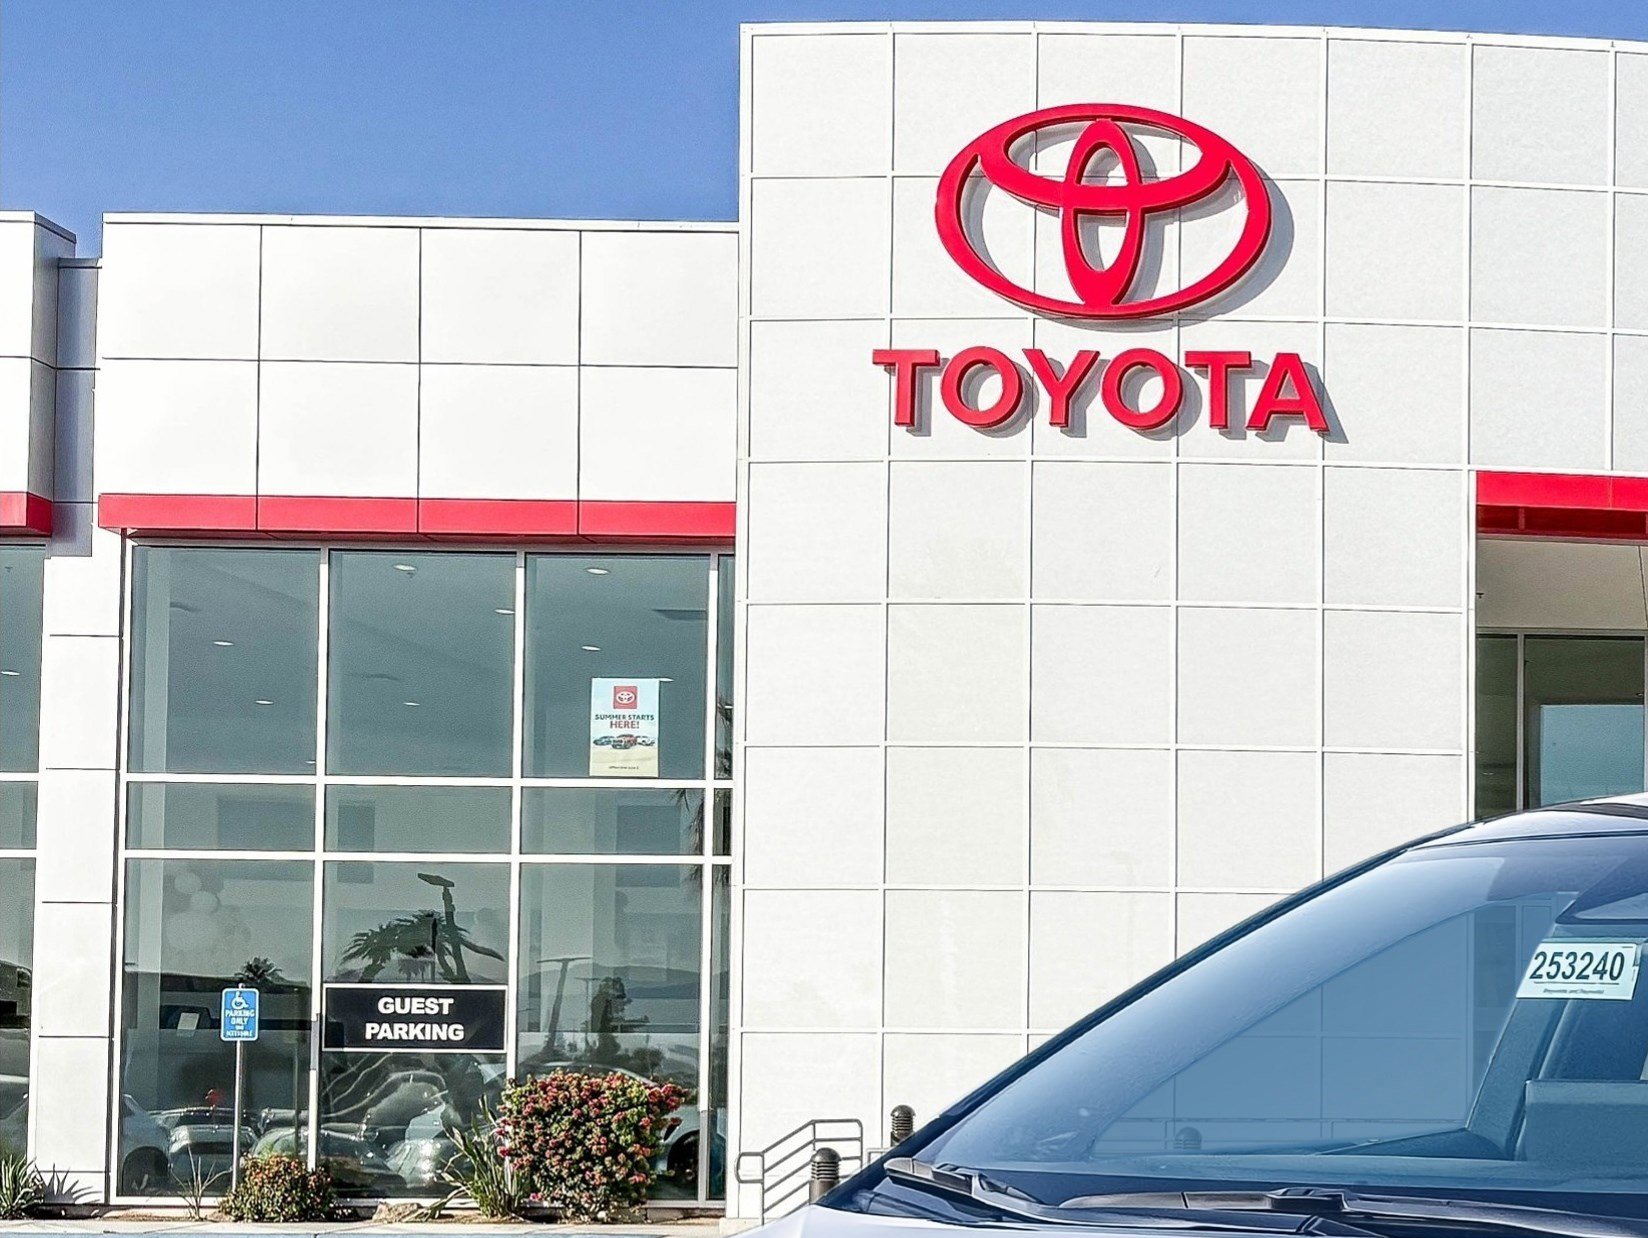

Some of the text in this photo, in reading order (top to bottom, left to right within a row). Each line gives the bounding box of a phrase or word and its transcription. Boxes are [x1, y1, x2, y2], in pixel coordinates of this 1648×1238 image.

[873, 346, 1329, 432] TOYOTA
[610, 720, 640, 729] HERE!
[1529, 951, 1625, 981] 253240
[377, 996, 455, 1015] GUEST
[365, 1022, 465, 1042] PARKING
